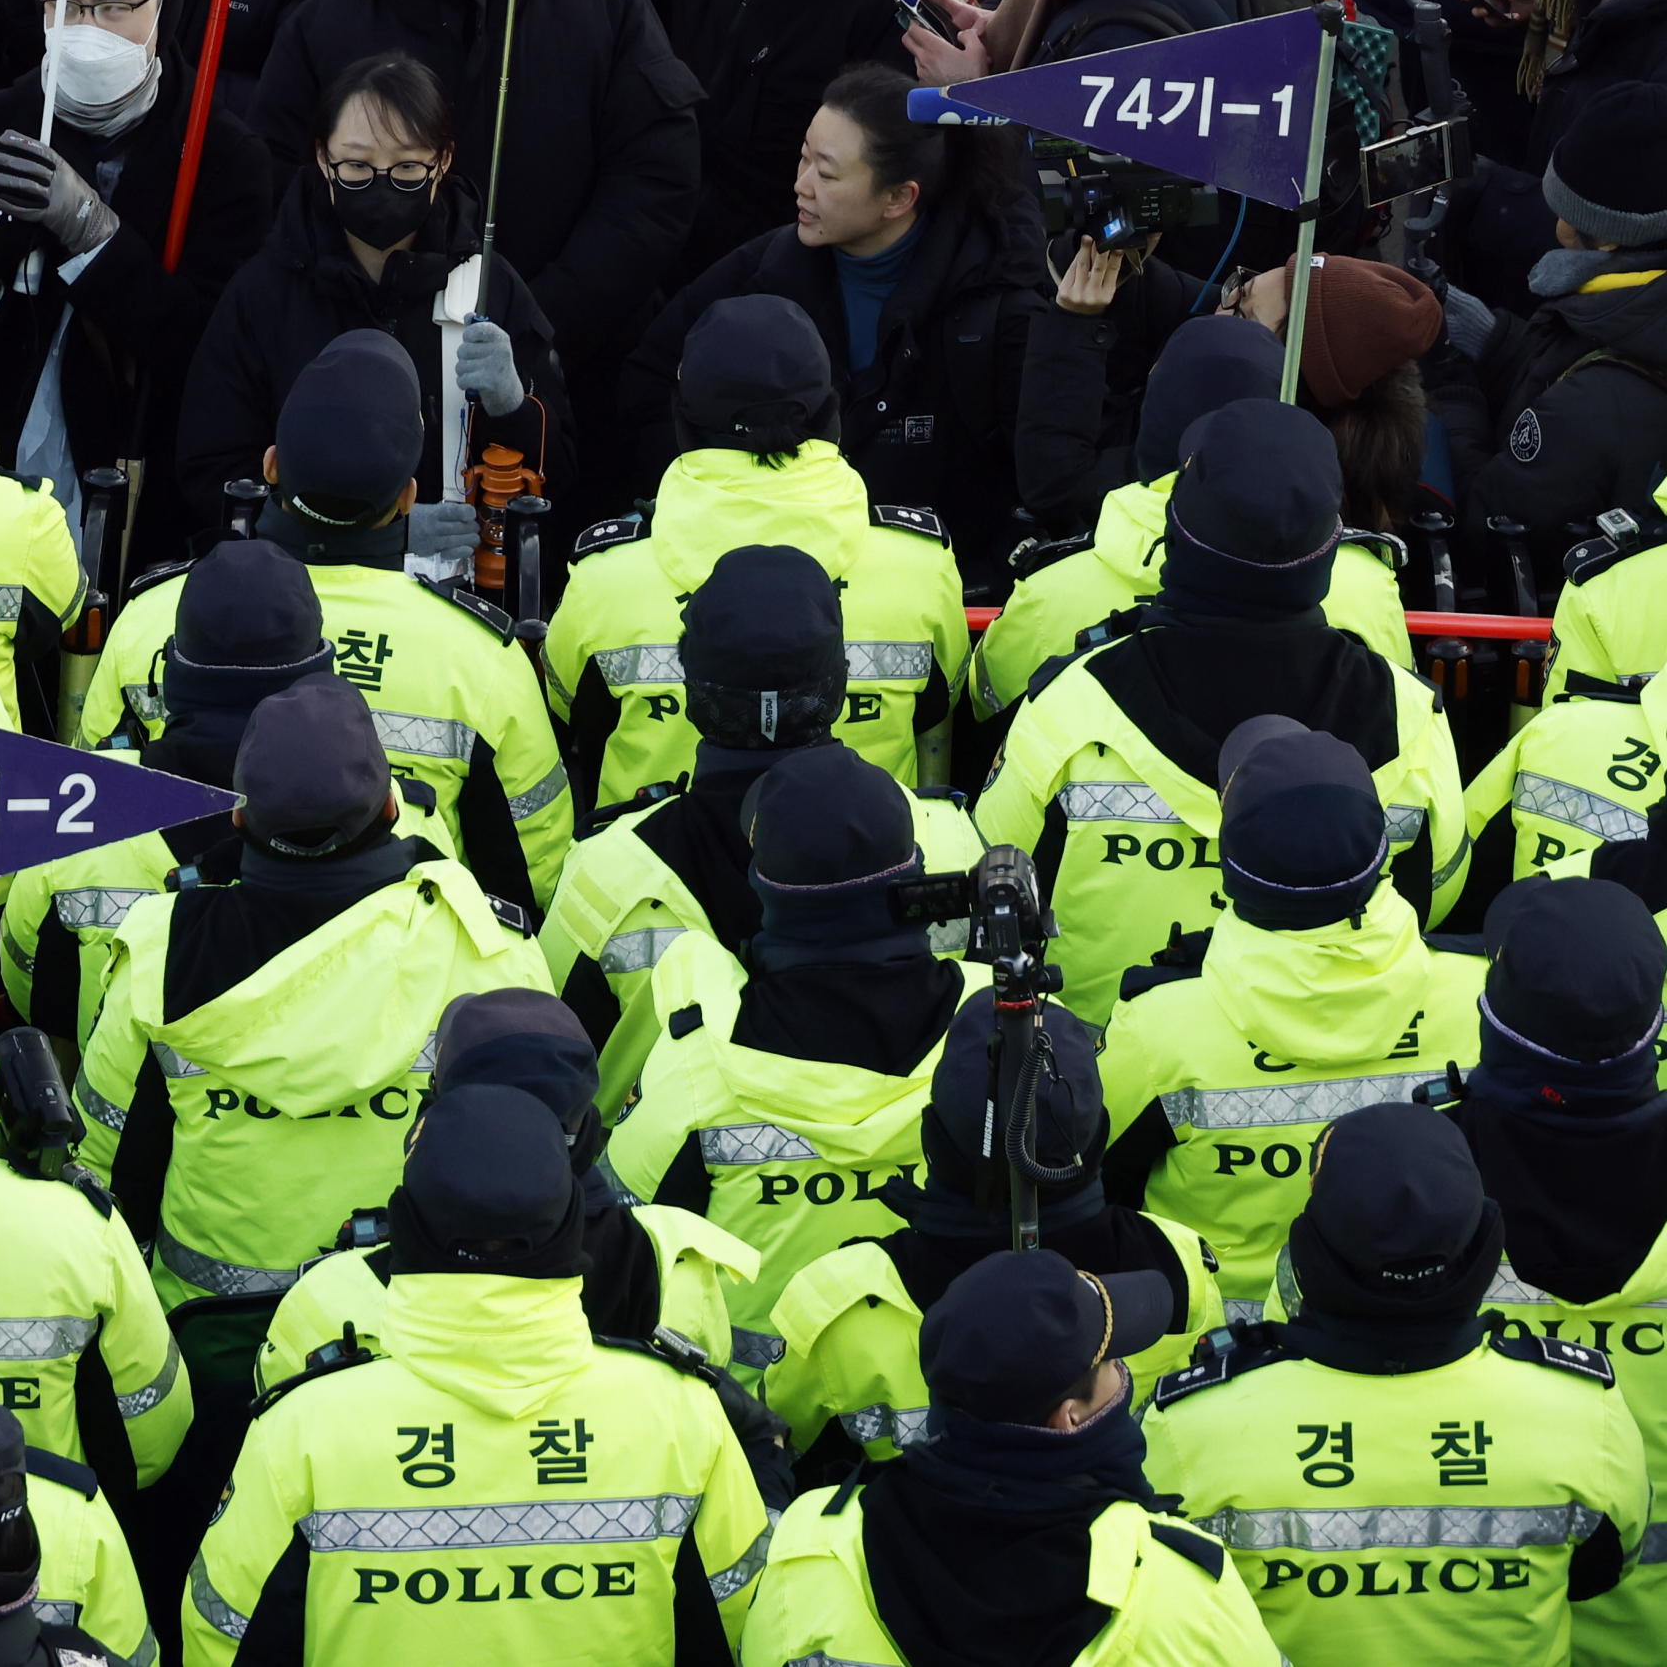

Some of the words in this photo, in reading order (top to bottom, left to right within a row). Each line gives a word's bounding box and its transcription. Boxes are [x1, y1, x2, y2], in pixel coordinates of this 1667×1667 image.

[1078, 75, 1294, 138] 74기-1
[1100, 834, 1221, 871] POL
[1381, 1263, 1447, 1283] POLICE
[353, 1561, 638, 1606] POLICE
[1266, 1558, 1531, 1599] POLICE
